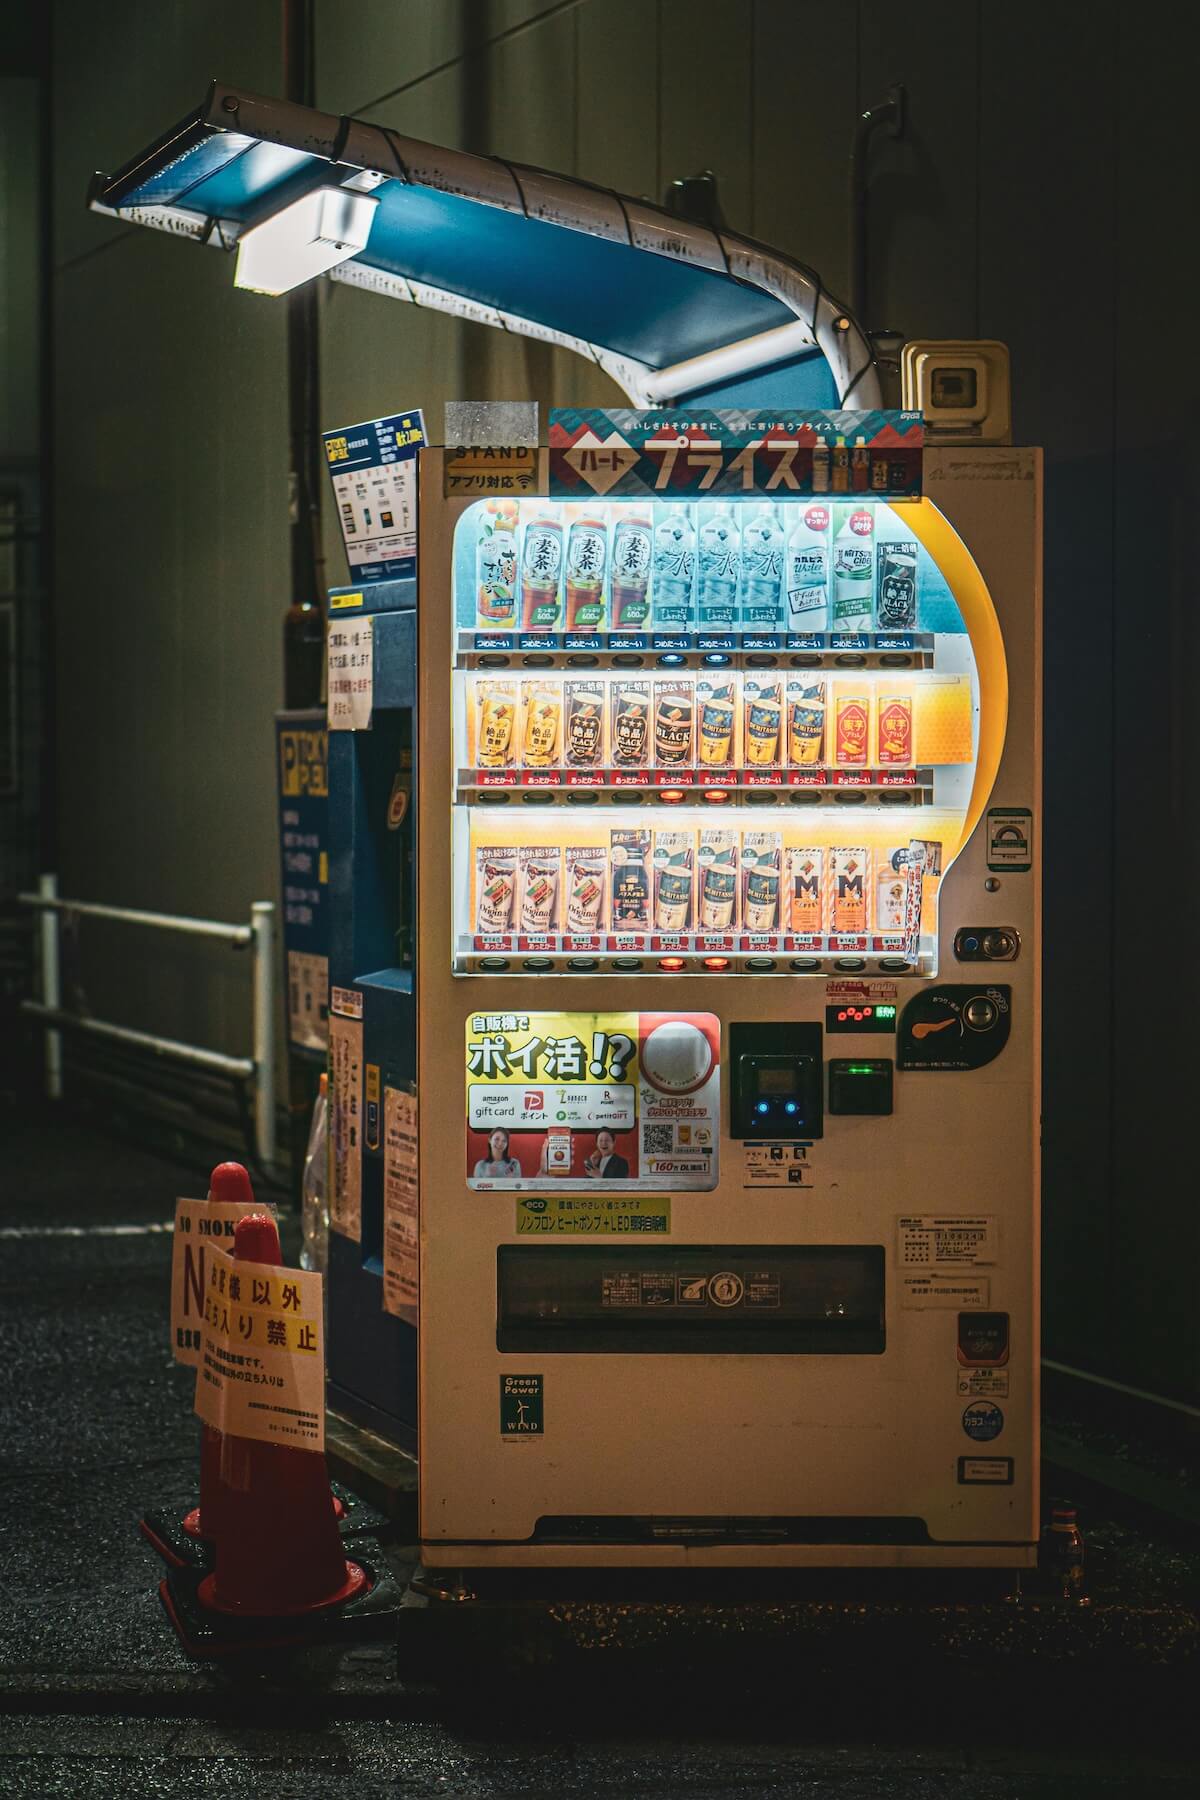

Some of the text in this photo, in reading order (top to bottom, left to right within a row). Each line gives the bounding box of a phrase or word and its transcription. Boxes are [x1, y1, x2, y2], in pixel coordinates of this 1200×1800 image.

[455, 446, 528, 459] STAND
[579, 449, 624, 471] ハート
[644, 436, 801, 490] プライス
[449, 475, 515, 489] アプリ対応
[534, 538, 553, 570] 麦茶
[578, 538, 597, 570] 麦茶
[622, 536, 642, 569] 麦茶
[666, 551, 694, 577] 水
[710, 551, 736, 577] 水
[753, 551, 781, 577] 水
[656, 728, 691, 742] BLACK
[794, 876, 819, 898] M
[838, 875, 863, 898] M
[472, 1016, 529, 1033] 自販機で
[482, 1096, 509, 1105] amazon
[476, 1106, 515, 1119] gift card
[520, 1111, 549, 1121] ポイント
[180, 1216, 238, 1237] NO SMOK
[211, 1262, 302, 1311] お客様以外
[505, 1377, 538, 1386] Green
[505, 1385, 540, 1394] Power
[507, 1422, 538, 1431] WIND
